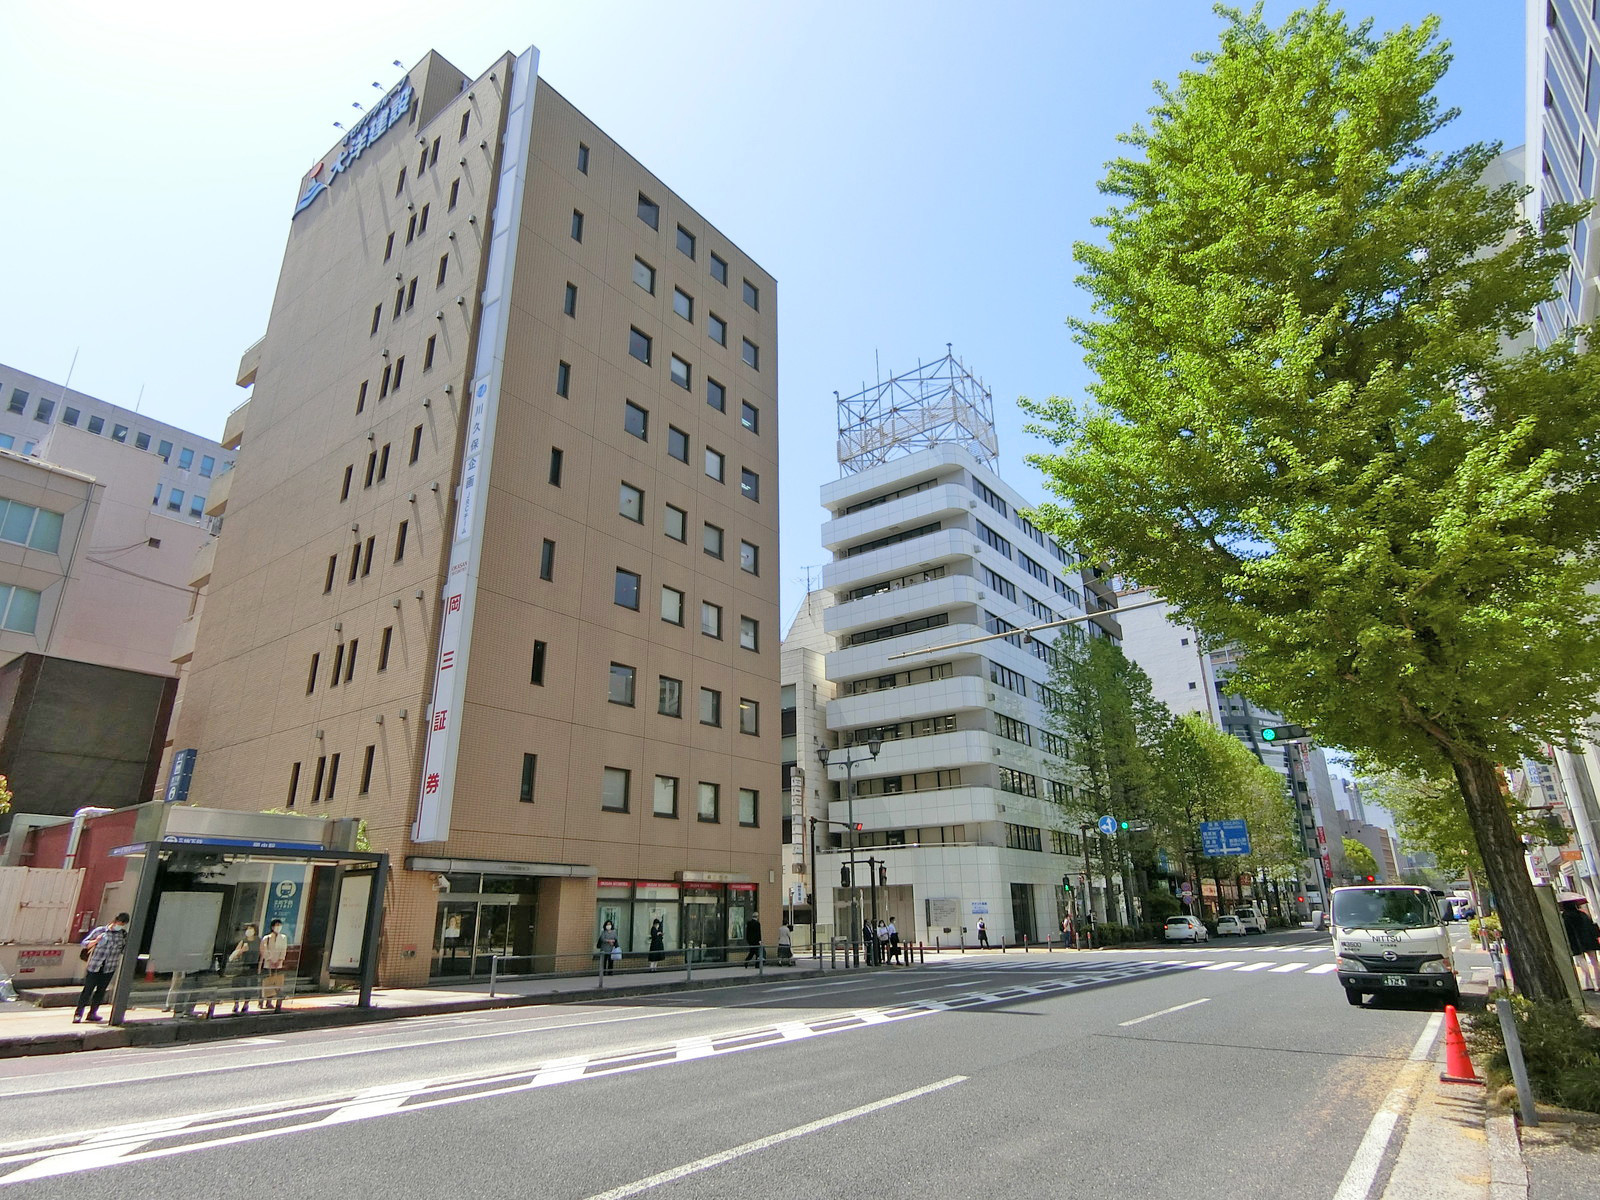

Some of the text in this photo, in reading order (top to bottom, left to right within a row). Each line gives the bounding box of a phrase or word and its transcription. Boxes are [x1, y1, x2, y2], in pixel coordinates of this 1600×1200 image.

[328, 84, 414, 186] 大洋建設
[465, 403, 484, 489] 川久保企画
[426, 593, 462, 795] 岡三証券
[1371, 935, 1402, 943] NITTSU
